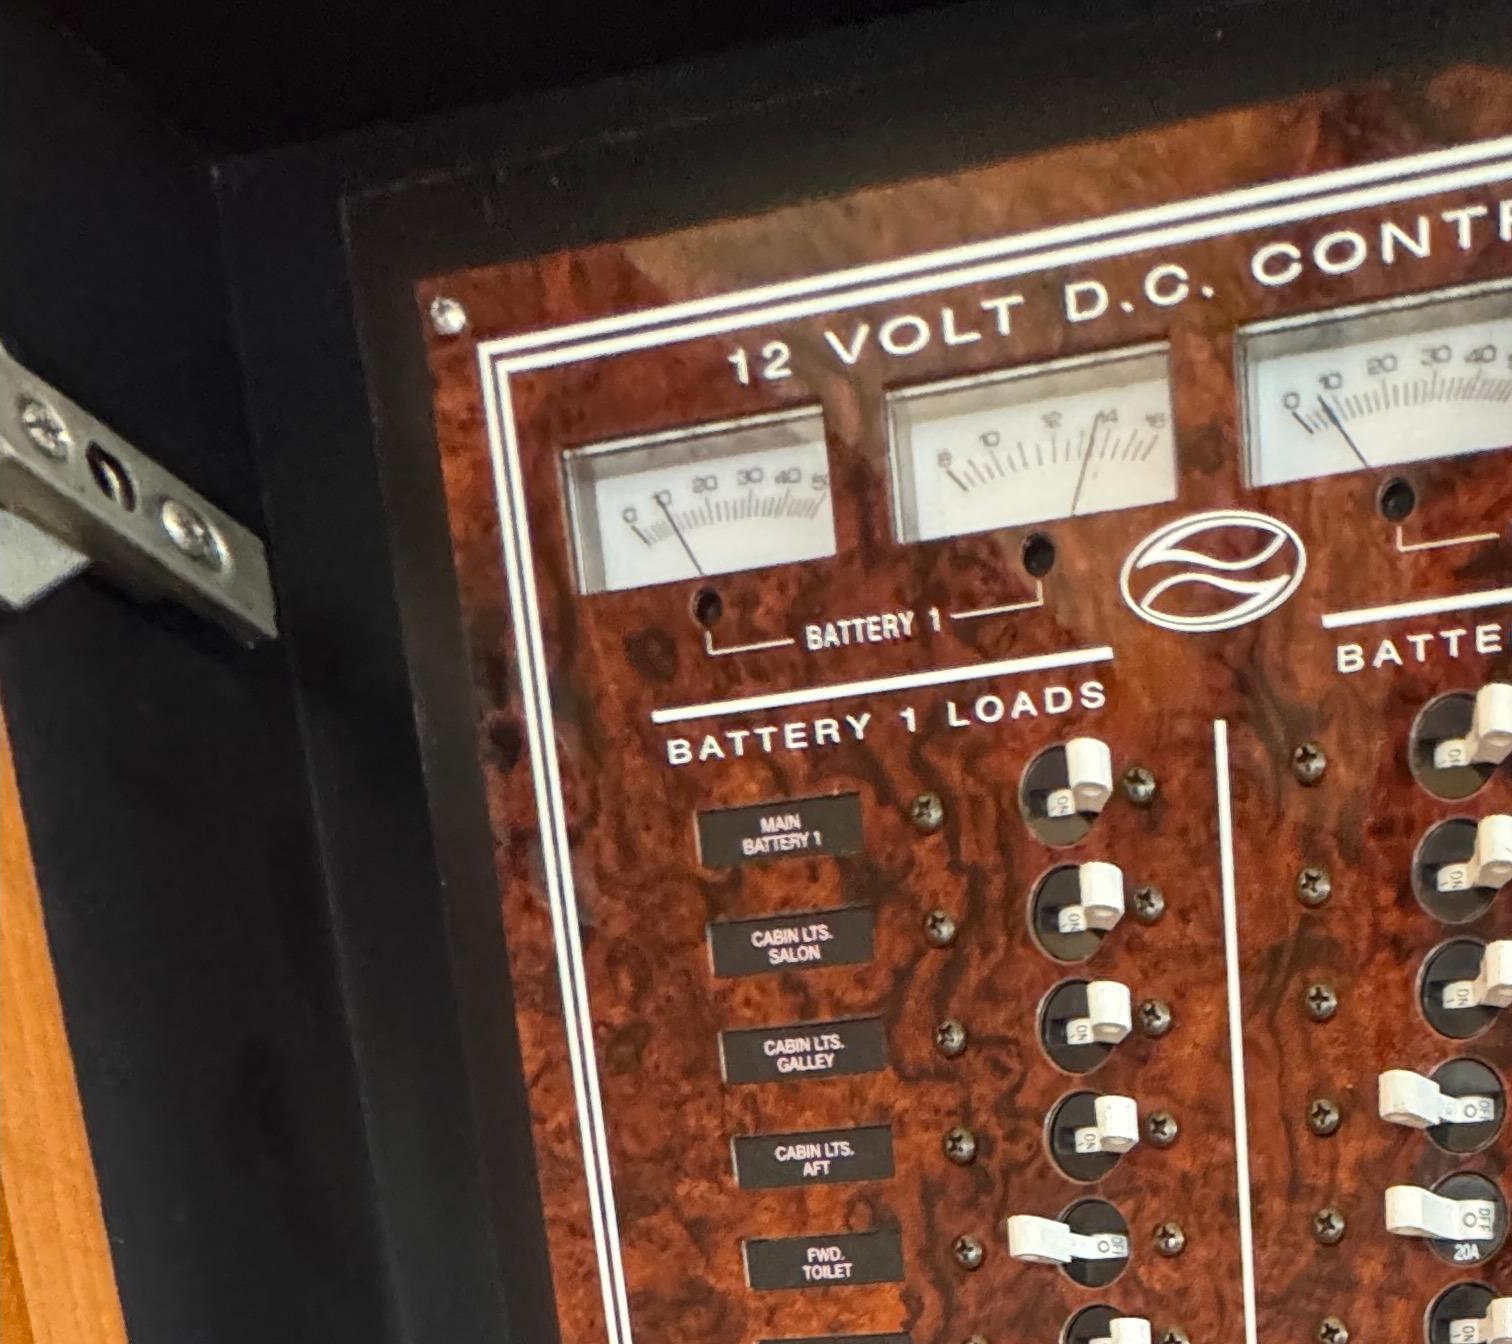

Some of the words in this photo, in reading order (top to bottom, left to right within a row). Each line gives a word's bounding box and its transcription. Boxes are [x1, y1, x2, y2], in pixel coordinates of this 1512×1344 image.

[730, 343, 792, 385] 12
[825, 295, 1025, 365] VOLT
[1065, 263, 1215, 321] D.C.
[805, 615, 918, 652] BATTERY
[930, 609, 942, 636] 1
[667, 713, 871, 765] BATTERY
[902, 707, 918, 734] 1
[948, 681, 1108, 728] LOADS
[760, 814, 801, 833] MAIN
[742, 832, 810, 855] BATTERY
[814, 831, 821, 846] 1
[751, 928, 799, 948] CABIN
[801, 924, 833, 941] LTS.
[769, 945, 821, 964] SALON
[764, 1037, 811, 1056] CABIN
[813, 1034, 845, 1050] LTS.
[776, 1053, 835, 1073] GALLEY
[774, 1144, 821, 1162] CABIN
[824, 1141, 855, 1157] LTS.
[803, 1160, 832, 1176] AFT
[807, 1247, 845, 1263] FWD.
[1453, 1243, 1480, 1261] 20A
[802, 1263, 853, 1280] TOILET
